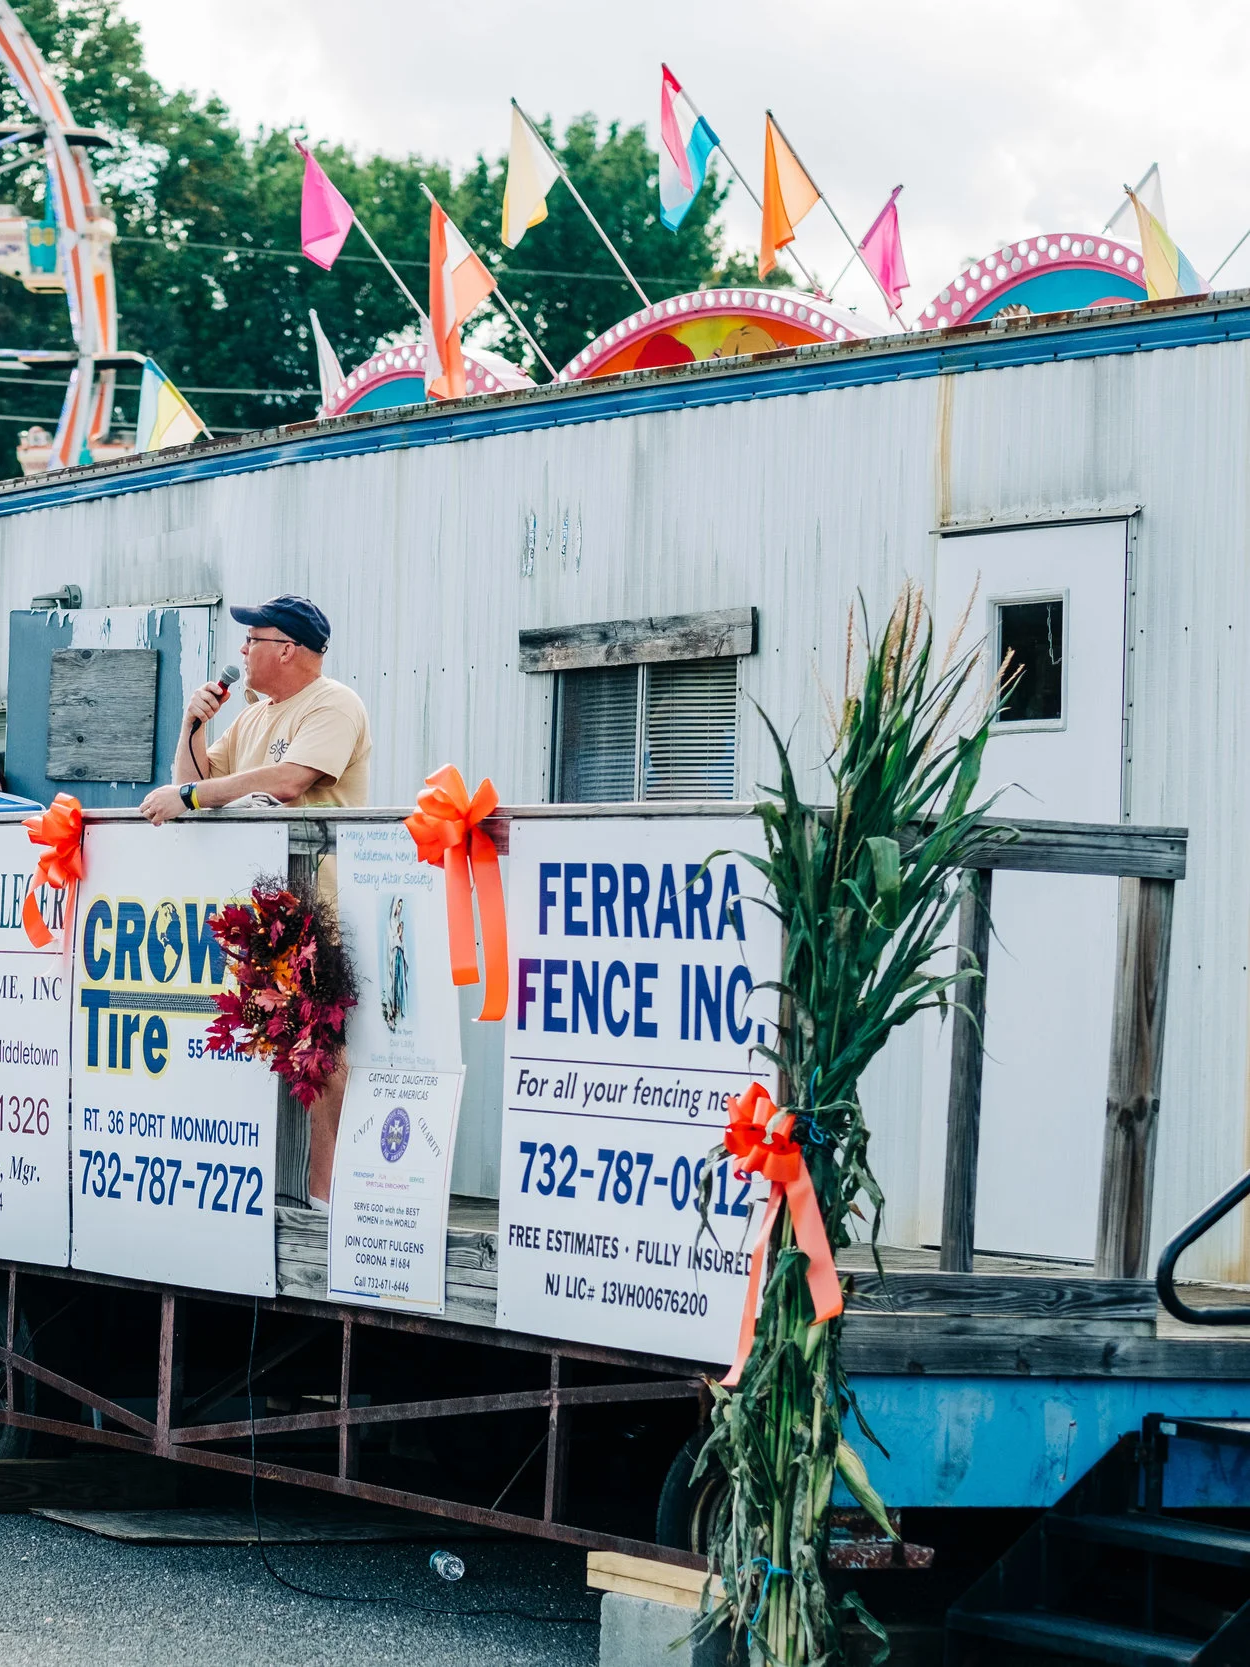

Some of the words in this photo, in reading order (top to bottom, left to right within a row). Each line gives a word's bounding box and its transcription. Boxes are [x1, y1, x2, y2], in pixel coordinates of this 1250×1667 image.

[353, 872, 379, 891] Rosary
[382, 870, 402, 885] Altar
[404, 871, 433, 891] Society
[539, 863, 746, 941] FERRARA
[84, 899, 242, 984] CROW
[32, 976, 63, 1001] INC
[517, 958, 658, 1038] FENCE
[680, 964, 765, 1045] INC.
[81, 989, 168, 1073] Tire
[188, 1039, 203, 1059] 55
[368, 1072, 400, 1084] CATHOLIC
[401, 1074, 438, 1086] DAUGHTERS
[516, 1069, 548, 1097] For
[553, 1072, 578, 1101] all
[582, 1080, 628, 1108] your
[633, 1077, 703, 1118] fencing
[373, 1088, 382, 1098] OF
[384, 1088, 396, 1099] THE
[398, 1090, 429, 1101] AMERICAS
[84, 1107, 102, 1132] RT.
[108, 1109, 124, 1135] 36
[129, 1112, 165, 1138] PORT
[171, 1116, 259, 1147] MONMOUTH
[417, 1117, 442, 1158] CHARITY
[9, 1156, 40, 1186] Mgr.
[79, 1149, 263, 1216] 732-787-7272
[353, 1201, 370, 1211] SERVE
[371, 1203, 384, 1213] GOD
[385, 1205, 395, 1214] with
[396, 1206, 404, 1215] the
[405, 1207, 420, 1216] BEST
[357, 1214, 379, 1225] WOMEN
[379, 1217, 384, 1225] in
[385, 1218, 393, 1226] the
[345, 1235, 360, 1248] JOIN
[362, 1237, 387, 1250] COURT
[389, 1240, 424, 1254] FULGENS
[509, 1224, 541, 1250] FREE
[547, 1229, 619, 1260] ESTIMATES
[636, 1240, 682, 1268] FULLY
[355, 1253, 387, 1267] CORONA
[390, 1258, 410, 1270] #1684
[354, 1276, 366, 1287] Call
[368, 1278, 409, 1293] 732-671-6446
[545, 1273, 560, 1297] NJ
[565, 1275, 595, 1301] LIC#
[601, 1281, 708, 1317] 13VH00676200
